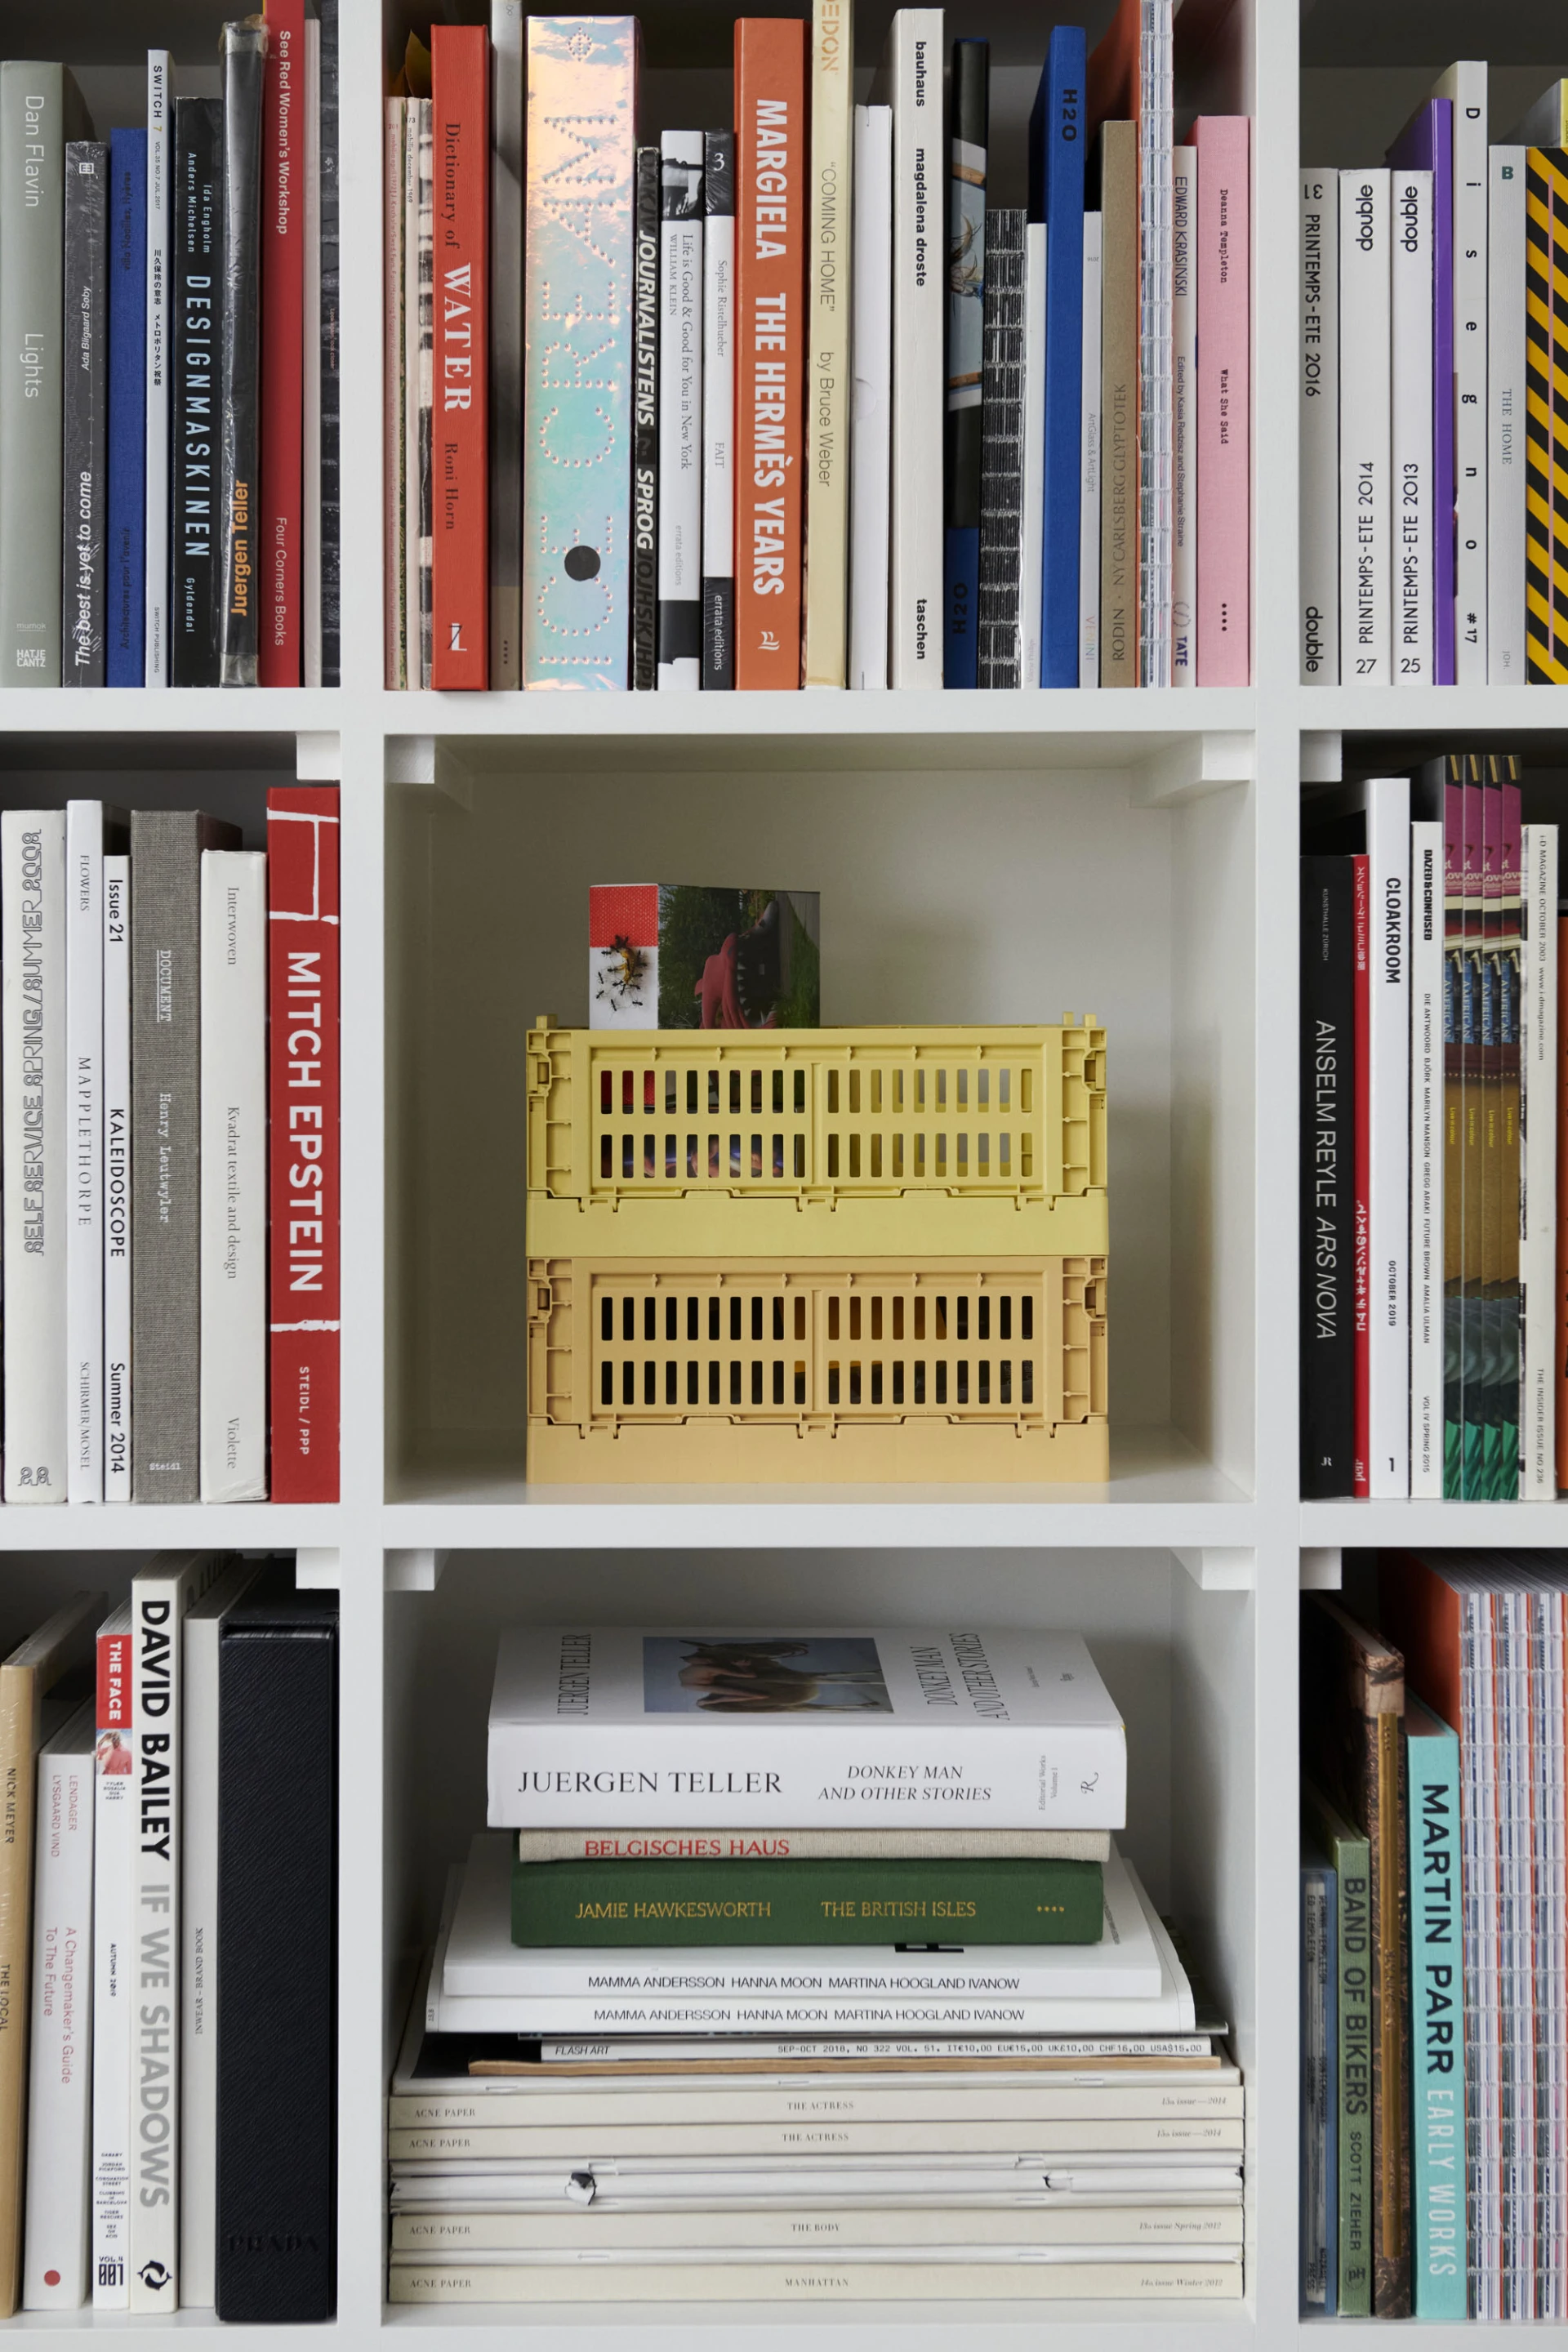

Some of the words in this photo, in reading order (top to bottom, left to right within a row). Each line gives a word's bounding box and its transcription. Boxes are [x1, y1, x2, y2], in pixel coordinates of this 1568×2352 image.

[279, 31, 291, 57] See
[154, 65, 162, 118] SWITCH
[278, 61, 290, 89] Red
[915, 42, 927, 107] bauhaus
[25, 96, 44, 136] Dan
[25, 145, 44, 207] Flavin
[188, 153, 196, 191] Anders
[203, 185, 212, 202] Ida
[442, 123, 461, 221] Dictionary
[756, 100, 787, 259] MARGIELA
[915, 148, 927, 233] magdalena
[1502, 166, 1513, 180] B
[276, 161, 290, 234] Workshop
[1174, 177, 1187, 227] EDWARD
[1220, 189, 1229, 226] Deanna
[1356, 185, 1373, 251] double
[1401, 186, 1418, 252] double
[188, 196, 197, 252] Michelsen
[202, 207, 212, 253] Engholm
[445, 230, 461, 248] of
[915, 238, 927, 286] droste
[1174, 231, 1191, 296] KRASIŃSKI
[1218, 231, 1229, 283] Templeton
[444, 262, 471, 412] WATER
[638, 230, 657, 425] JOURNALISTENS
[755, 293, 786, 350] THE
[20, 333, 43, 398] Lights
[817, 352, 833, 372] by
[1220, 369, 1229, 394] What
[1305, 354, 1321, 397] 2016
[185, 275, 211, 557] DESIGNMASKINEN
[754, 362, 793, 487] HERMÈS
[819, 378, 833, 426] Bruce
[1220, 399, 1229, 416] She
[1502, 389, 1512, 416] THE
[1220, 421, 1229, 444] Said
[1502, 424, 1512, 465] HOME
[445, 443, 458, 481] Roni
[818, 432, 833, 487] Weber
[1359, 462, 1374, 506] 2014
[80, 471, 91, 519] come
[231, 480, 249, 534] Teller
[445, 489, 458, 530] Horn
[637, 469, 653, 550] SPROG
[1403, 464, 1417, 506] 2013
[78, 524, 91, 541] to
[274, 517, 287, 546] Four
[753, 497, 785, 595] YEARS
[77, 545, 91, 572] yet
[78, 577, 91, 588] is
[231, 540, 251, 616] Juergen
[274, 550, 287, 601] Corners
[76, 594, 91, 629] best
[185, 577, 194, 632] Gyldendal
[274, 606, 286, 645] Books
[916, 599, 927, 659] taschen
[76, 637, 91, 666] The
[1176, 637, 1187, 666] TATE
[1306, 607, 1323, 671] double
[1356, 659, 1377, 674] 27
[1401, 659, 1420, 673] 25
[22, 830, 42, 892] 2008
[80, 855, 90, 911] FLOWERS
[109, 880, 123, 919] Issue
[109, 924, 123, 942] 21
[227, 887, 239, 965] Interwoven
[1322, 934, 1330, 960] ZÜRICH
[1385, 878, 1401, 983] CLOAKROOM
[158, 950, 171, 1022] DOCUMENT
[287, 952, 321, 1087] MITCH
[1316, 1020, 1336, 1122] ANSELM
[157, 1094, 171, 1137] Henry
[227, 1107, 239, 1156] Kvadrat
[23, 1095, 43, 1192] SERVICE
[78, 1057, 91, 1227] MAPPLETHORPE
[109, 1108, 124, 1258] KALEIDOSCOPE
[157, 1146, 170, 1223] Leutwyler
[228, 1160, 239, 1204] textile
[1316, 1130, 1336, 1207] REYLE
[228, 1207, 239, 1232] and
[288, 1106, 323, 1292] EPSTEIN
[24, 1198, 43, 1256] SELF
[1316, 1217, 1337, 1268] ARS
[224, 1235, 239, 1279] design
[1388, 1260, 1396, 1301] OCTOBER
[1316, 1273, 1337, 1339] NOVA
[1388, 1304, 1396, 1326] 2019
[79, 1362, 90, 1470] SCHIRMER/MOSEL
[110, 1363, 124, 1426] Summer
[111, 1433, 125, 1473] 2014
[227, 1418, 239, 1468] Violette
[109, 1642, 122, 1673] THE
[141, 1601, 170, 1717] DAVID
[109, 1678, 122, 1719] FACE
[6, 1768, 17, 1799] NICK
[141, 1733, 170, 1860] BAILEY
[519, 1772, 658, 1793] JUERGEN
[668, 1772, 782, 1793] TELLER
[818, 1788, 857, 1801] AND
[861, 1788, 917, 1801] OTHER
[922, 1788, 991, 1801] STORIES
[848, 1766, 920, 1780] DONKEY
[924, 1766, 963, 1780] MAN
[5, 1802, 16, 1843] MEYER
[586, 1840, 721, 1856] BELGISCHES
[729, 1840, 790, 1856] HAUS
[1423, 1785, 1451, 1943] MARTIN
[141, 1885, 169, 1913] IF
[575, 1902, 627, 1918] JAMIE
[634, 1902, 771, 1918] HAWKESWORTH
[822, 1902, 855, 1916] THE
[862, 1902, 926, 1917] BRITISH
[933, 1901, 976, 1916] ISLES
[1343, 1878, 1366, 1953] BAND
[140, 1928, 169, 1989] WE
[589, 1976, 640, 1988] MAMMA
[644, 1976, 724, 1988] ANDERSSON
[731, 1976, 777, 1989] HANNA
[781, 1977, 822, 1988] MOON
[829, 1977, 887, 1989] MARTINA
[890, 1977, 965, 1989] HOOGLAND
[969, 1978, 1020, 1989] IVANOW
[1343, 1968, 1365, 2003] OF
[1425, 1965, 1454, 2074] PARR
[1345, 2015, 1368, 2115] BIKERS
[139, 2005, 170, 2207] SHADOWS
[1428, 2090, 1455, 2170] EARLY
[439, 2139, 470, 2147] PAPER
[806, 2133, 849, 2141] ACTRESS
[1349, 2132, 1361, 2184] SCOTT
[1349, 2193, 1361, 2251] ZIEHER
[1428, 2184, 1456, 2275] WORKS
